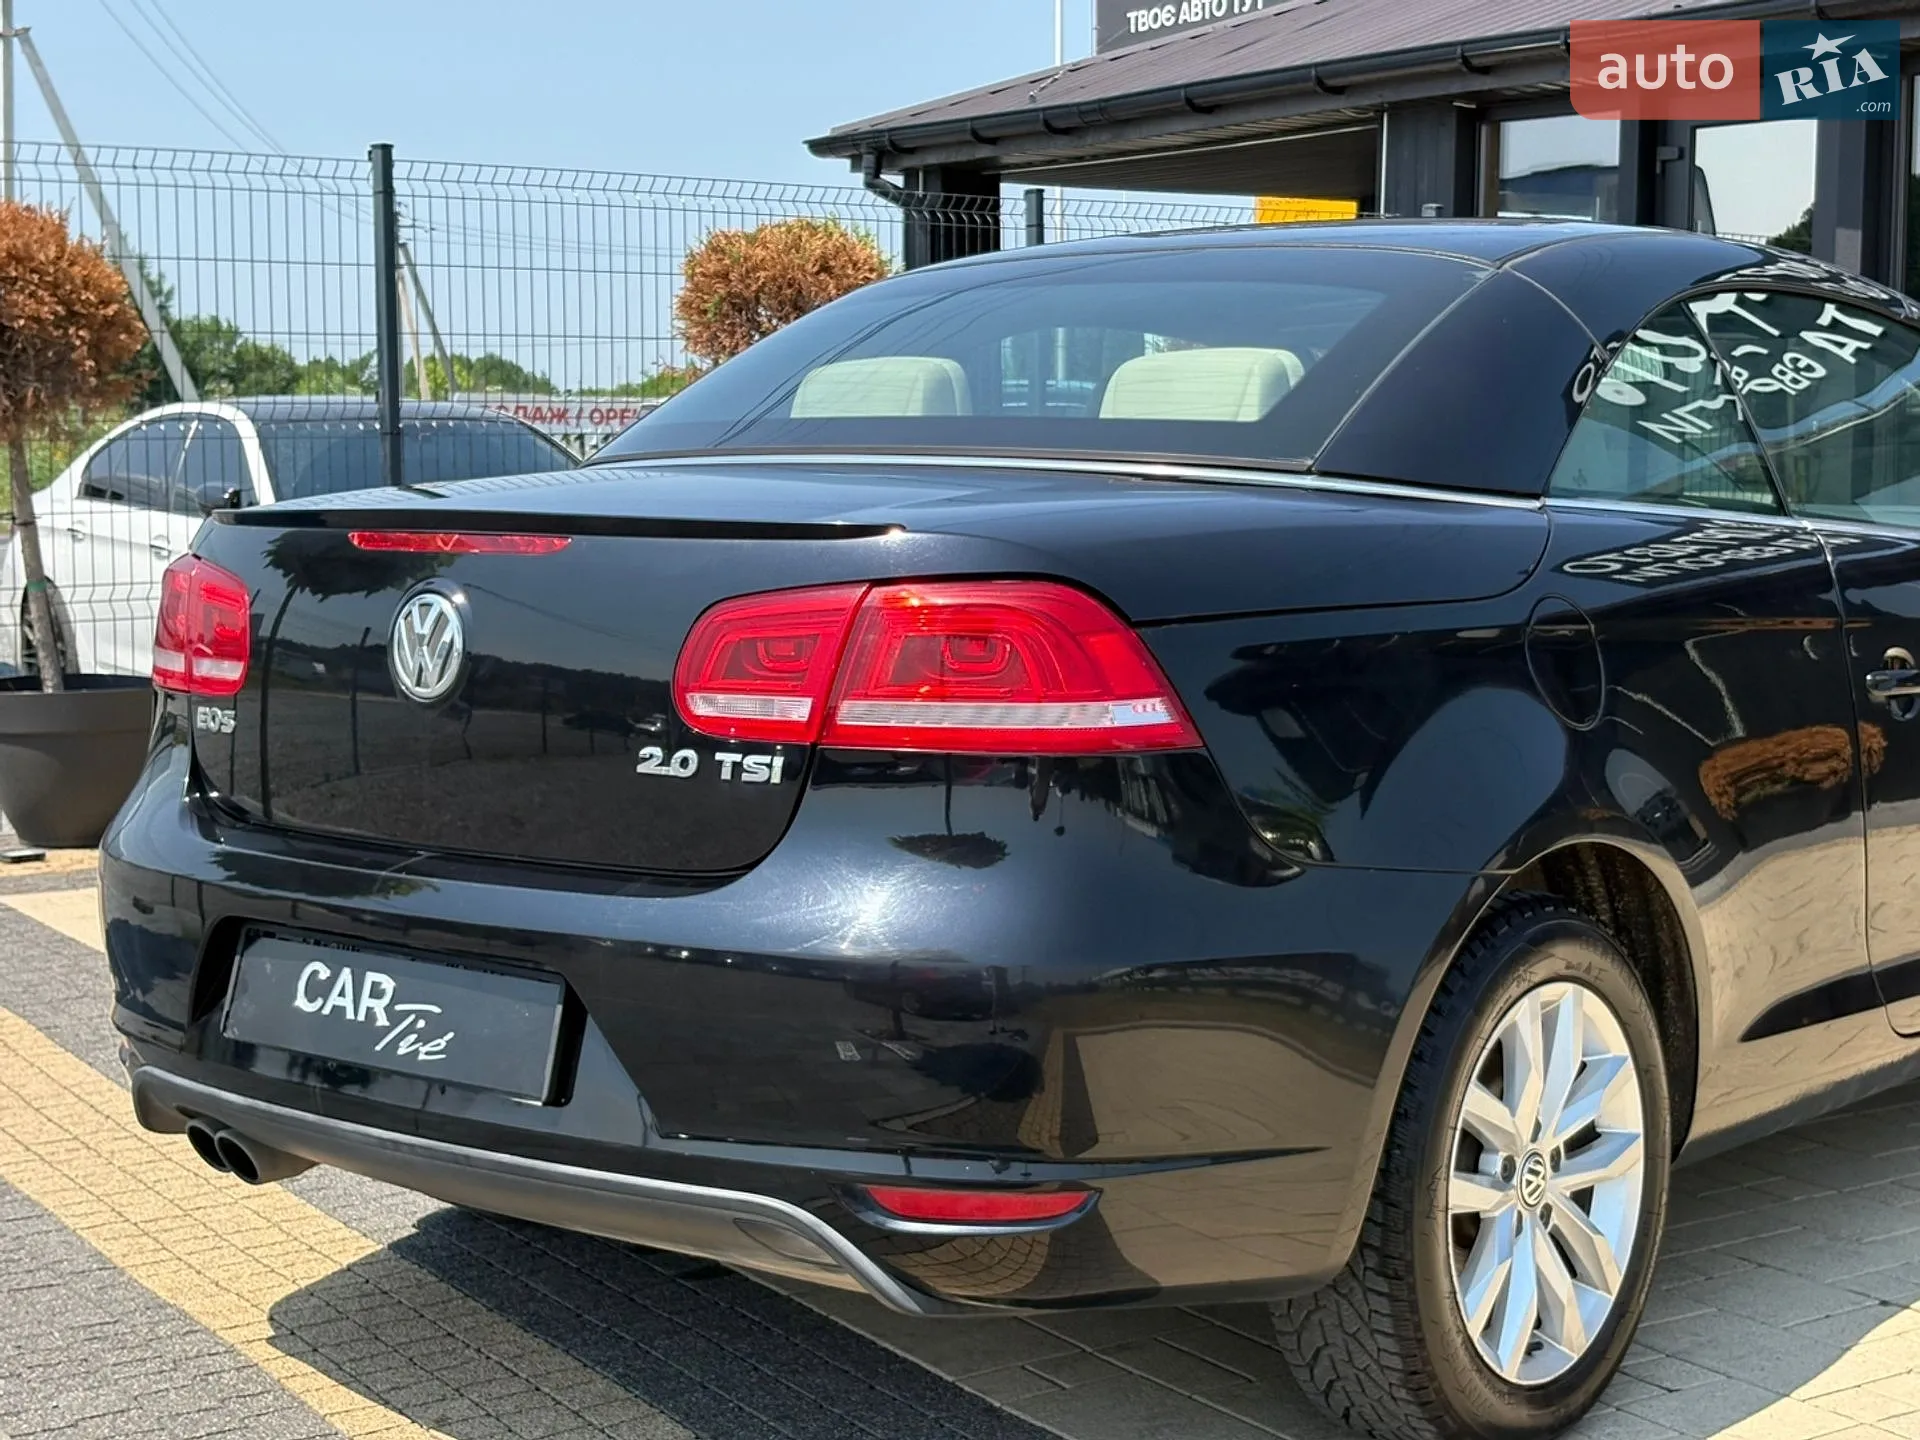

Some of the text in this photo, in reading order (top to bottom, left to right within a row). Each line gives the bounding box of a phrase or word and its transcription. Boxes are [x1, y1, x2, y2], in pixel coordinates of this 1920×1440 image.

[1127, 5, 1176, 33] ТВОЄ
[1178, 0, 1227, 24] АВТО
[197, 706, 236, 733] EOS
[636, 746, 784, 784] 2.0 TSI
[293, 961, 396, 1026] CAR
